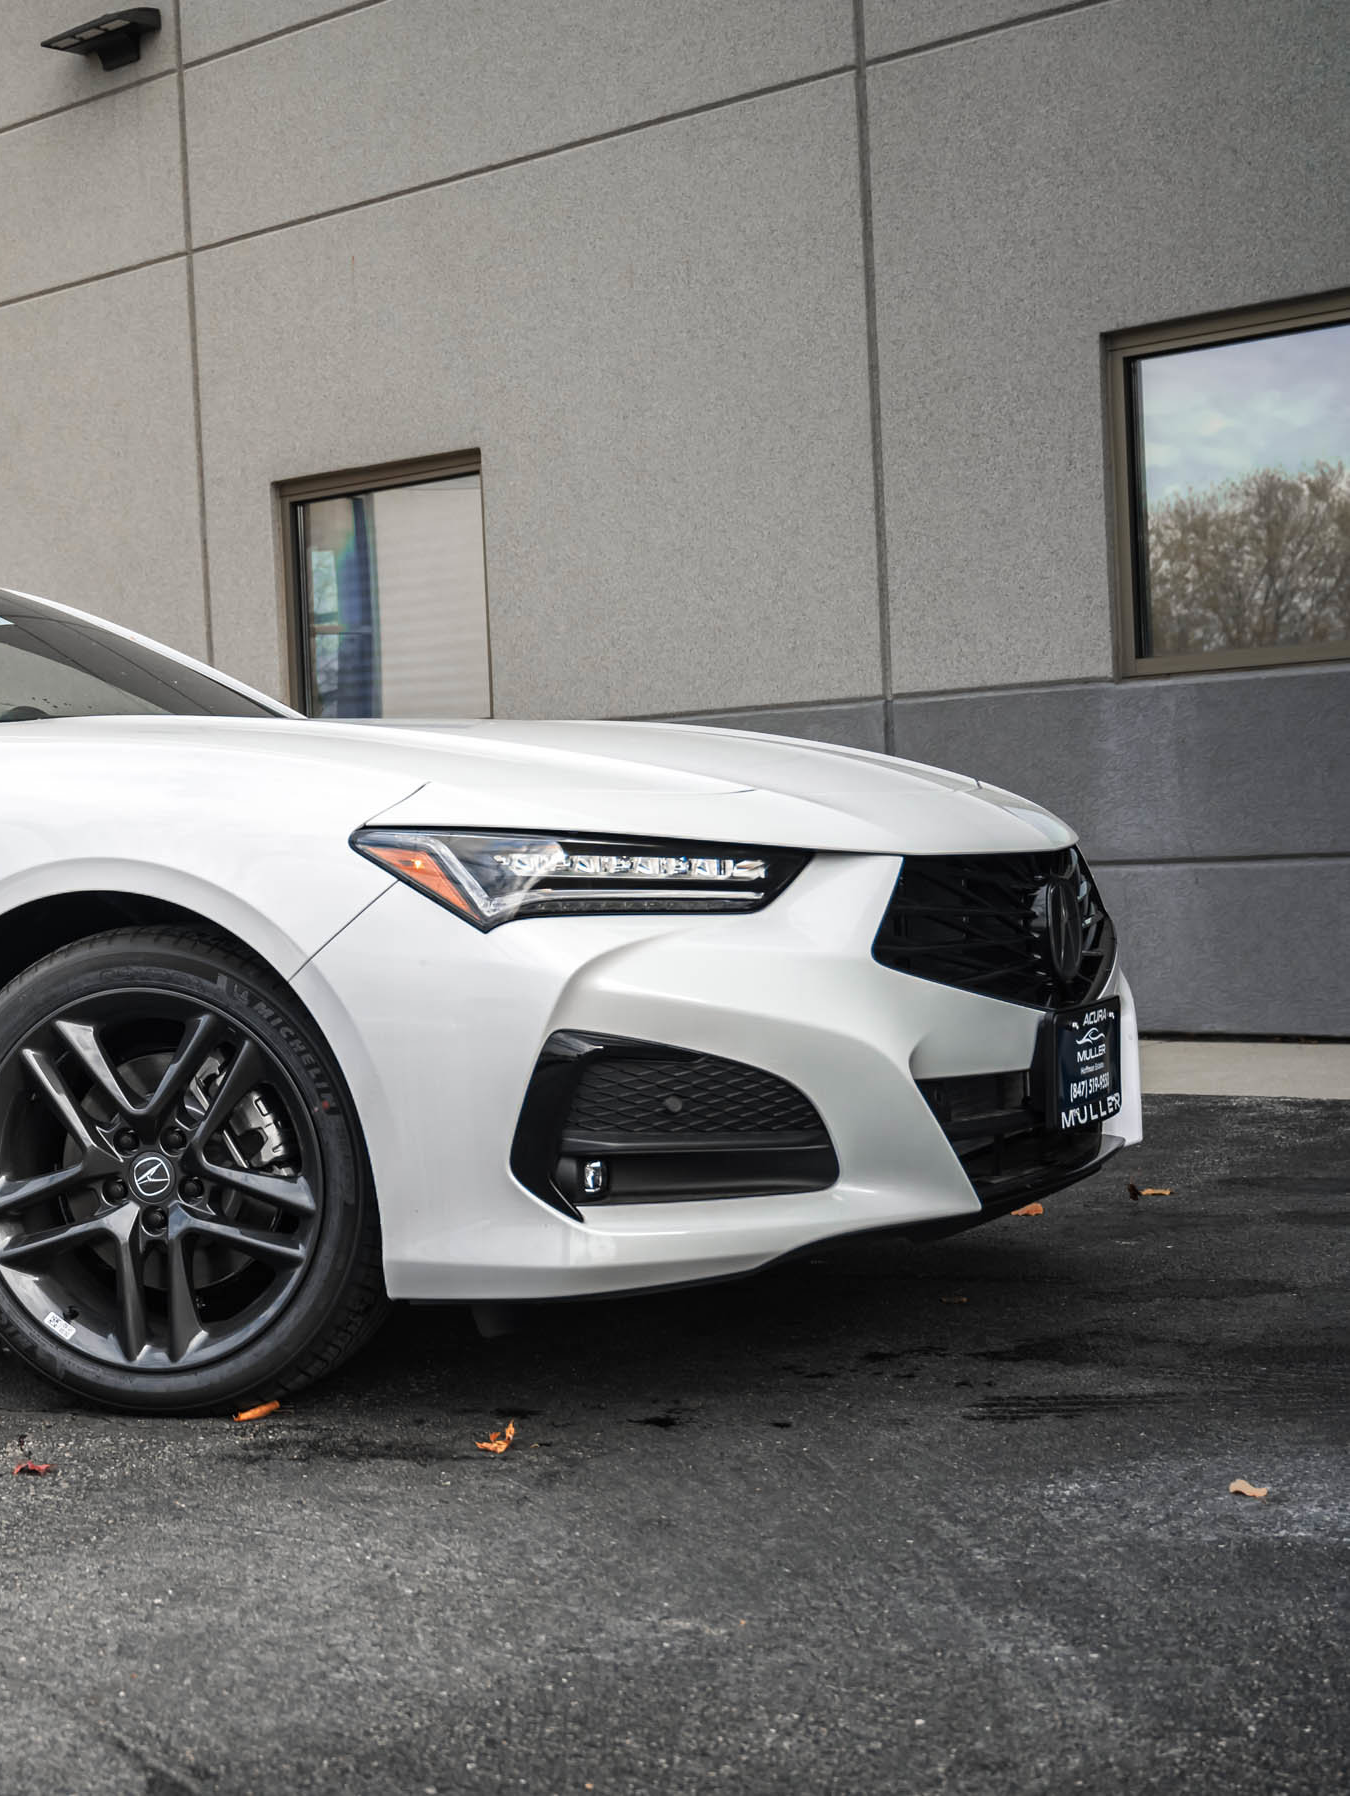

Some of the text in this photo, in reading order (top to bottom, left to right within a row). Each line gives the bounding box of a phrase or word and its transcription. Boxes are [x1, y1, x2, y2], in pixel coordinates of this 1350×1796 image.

[1082, 1009, 1107, 1026] ACURA
[253, 1001, 337, 1108] MICHELIN
[1077, 1044, 1106, 1062] MULLER
[1070, 1080, 1088, 1103] (847)
[1061, 1092, 1121, 1129] MULLER
